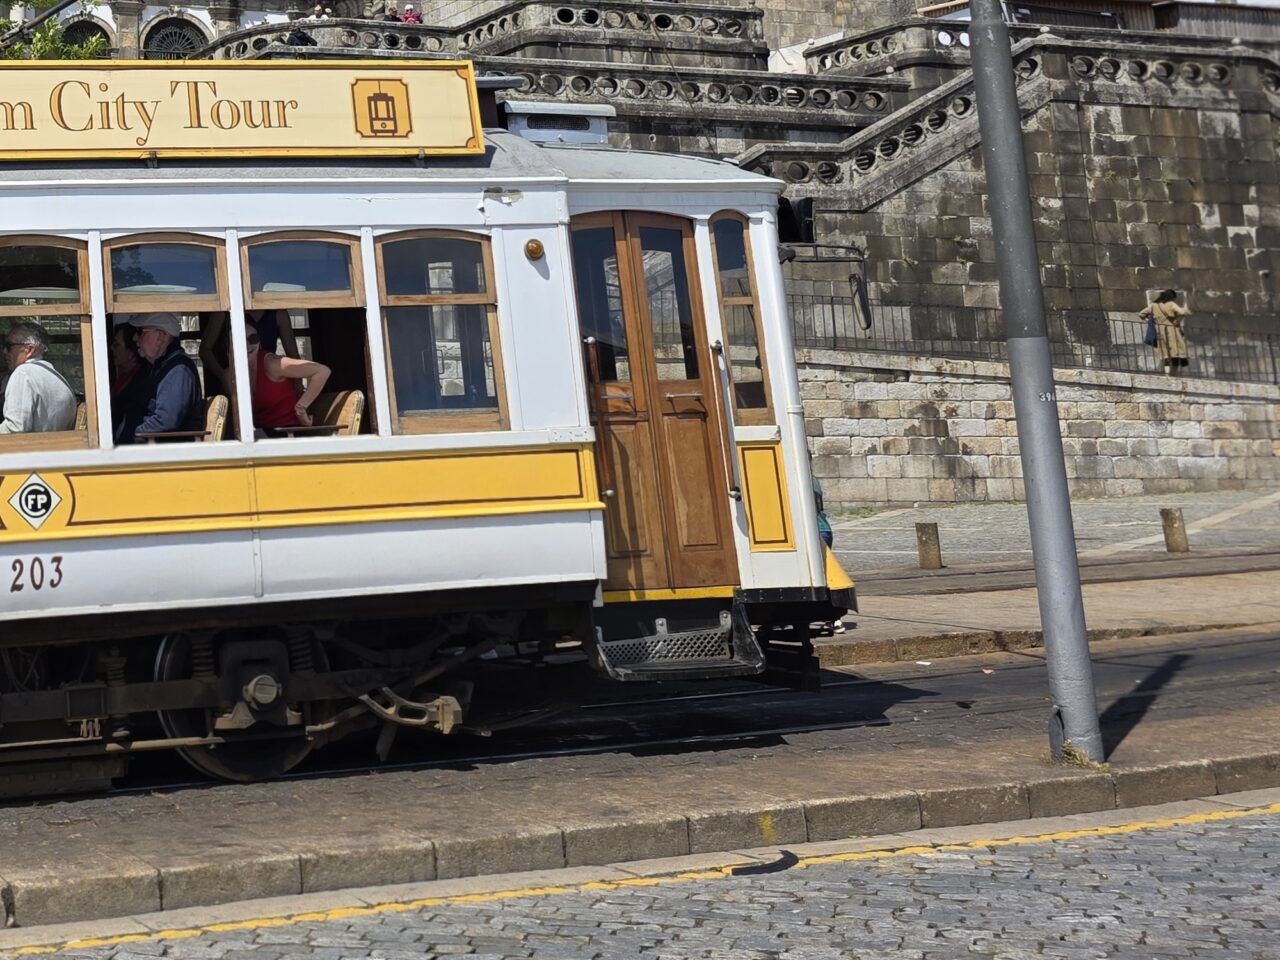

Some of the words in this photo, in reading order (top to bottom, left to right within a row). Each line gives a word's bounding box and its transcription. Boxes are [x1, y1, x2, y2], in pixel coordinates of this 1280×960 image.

[49, 80, 162, 146] City
[170, 80, 298, 130] Tour
[10, 556, 63, 593] 203
